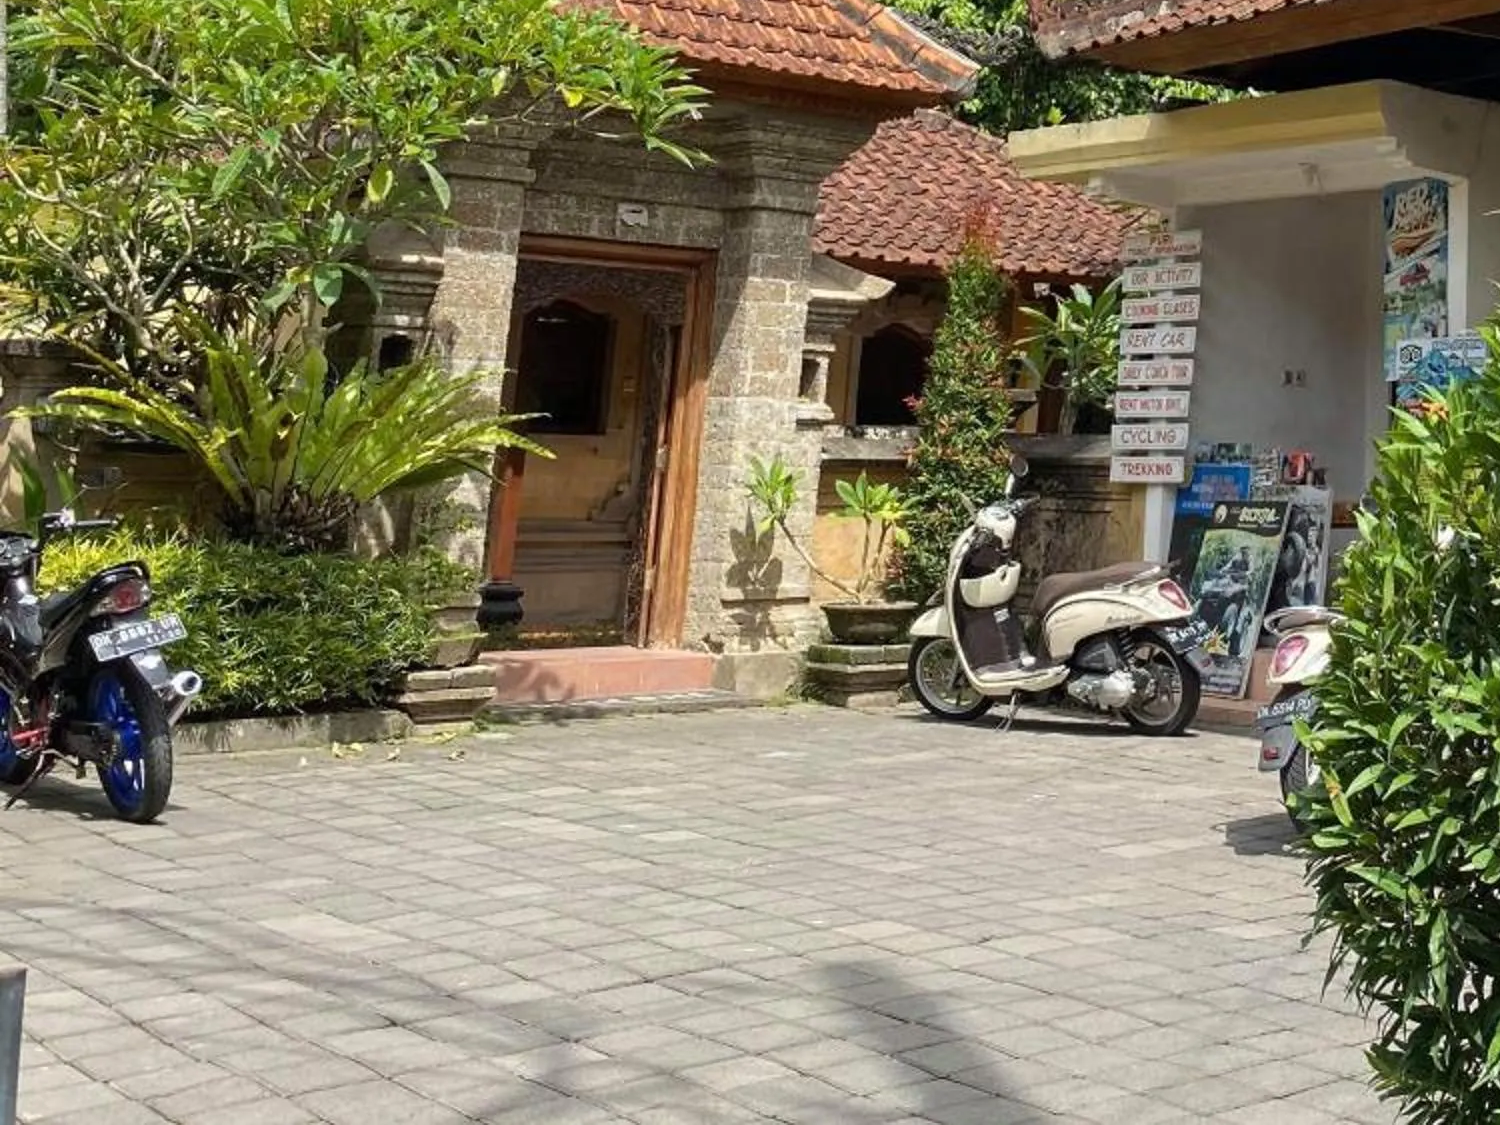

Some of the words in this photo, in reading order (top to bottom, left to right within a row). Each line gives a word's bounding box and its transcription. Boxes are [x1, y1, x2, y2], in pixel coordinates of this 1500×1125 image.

[1126, 333, 1156, 348] RENT
[1160, 332, 1186, 347] CAR
[1121, 429, 1177, 444] CYCLING
[1120, 462, 1173, 476] TREKKING
